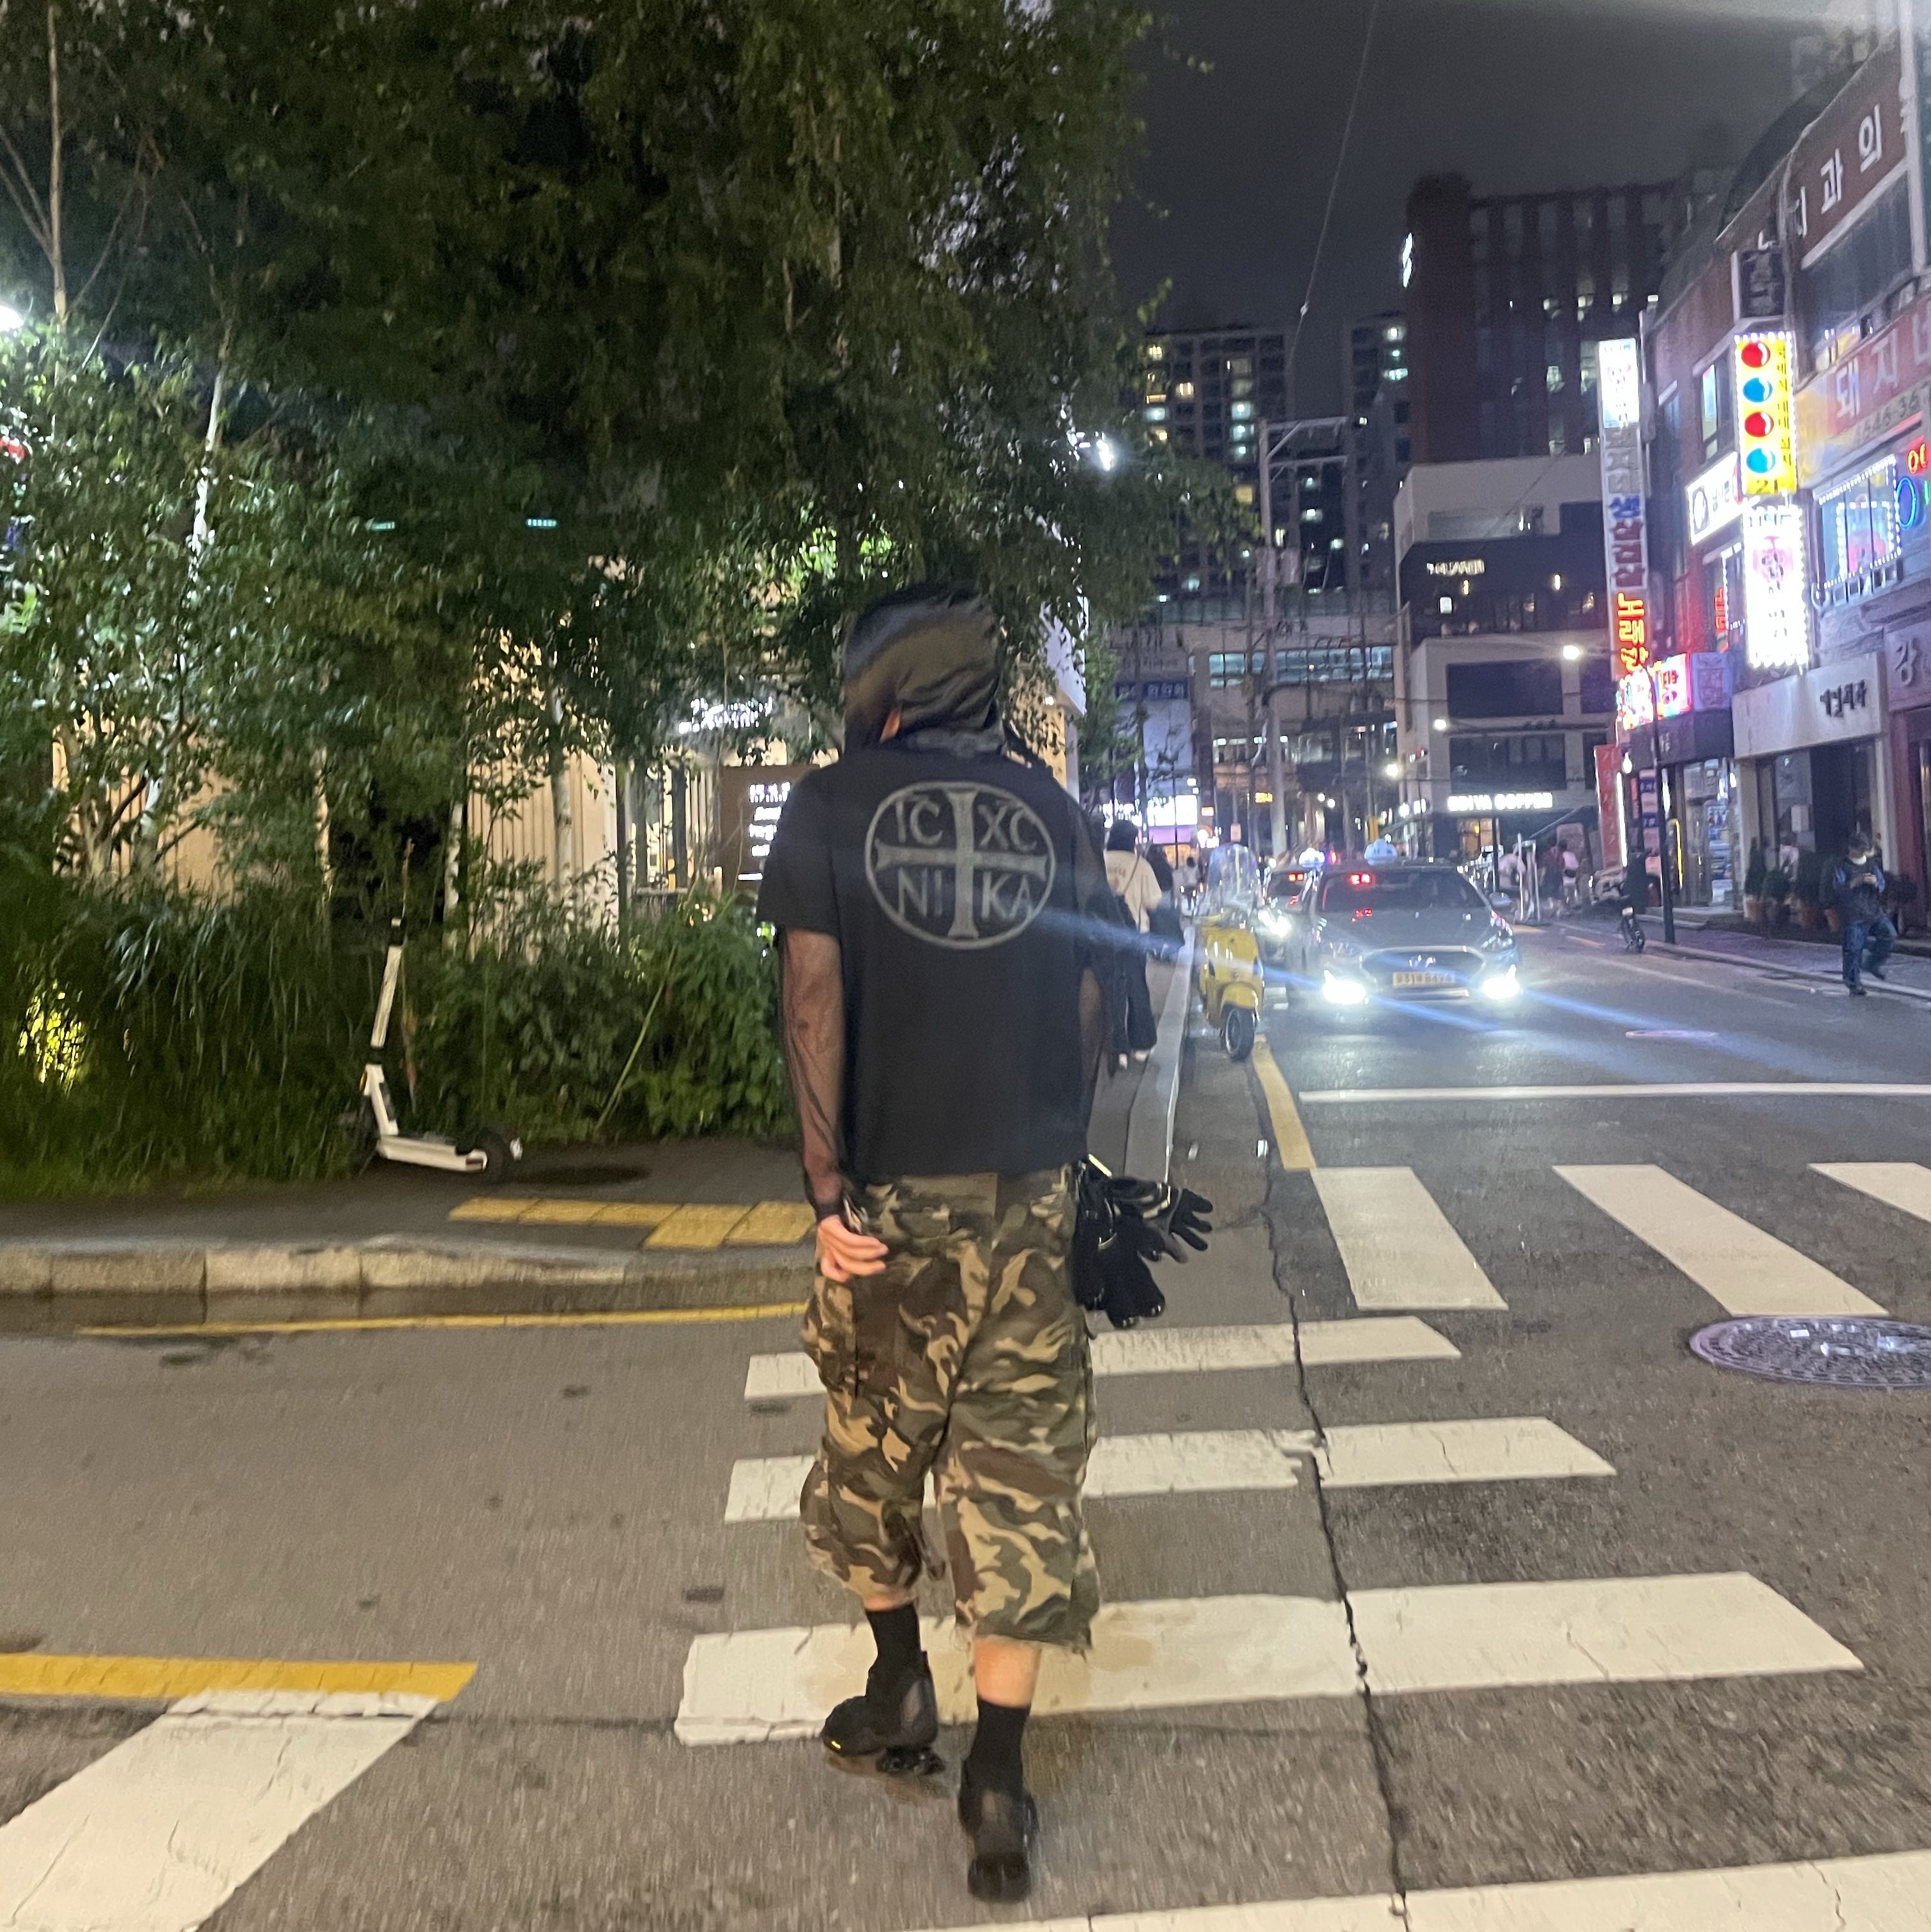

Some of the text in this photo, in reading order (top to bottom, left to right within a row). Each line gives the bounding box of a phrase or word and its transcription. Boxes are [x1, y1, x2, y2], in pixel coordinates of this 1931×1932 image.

[895, 796, 1037, 851] IC XC
[897, 867, 1034, 920] NI KA
